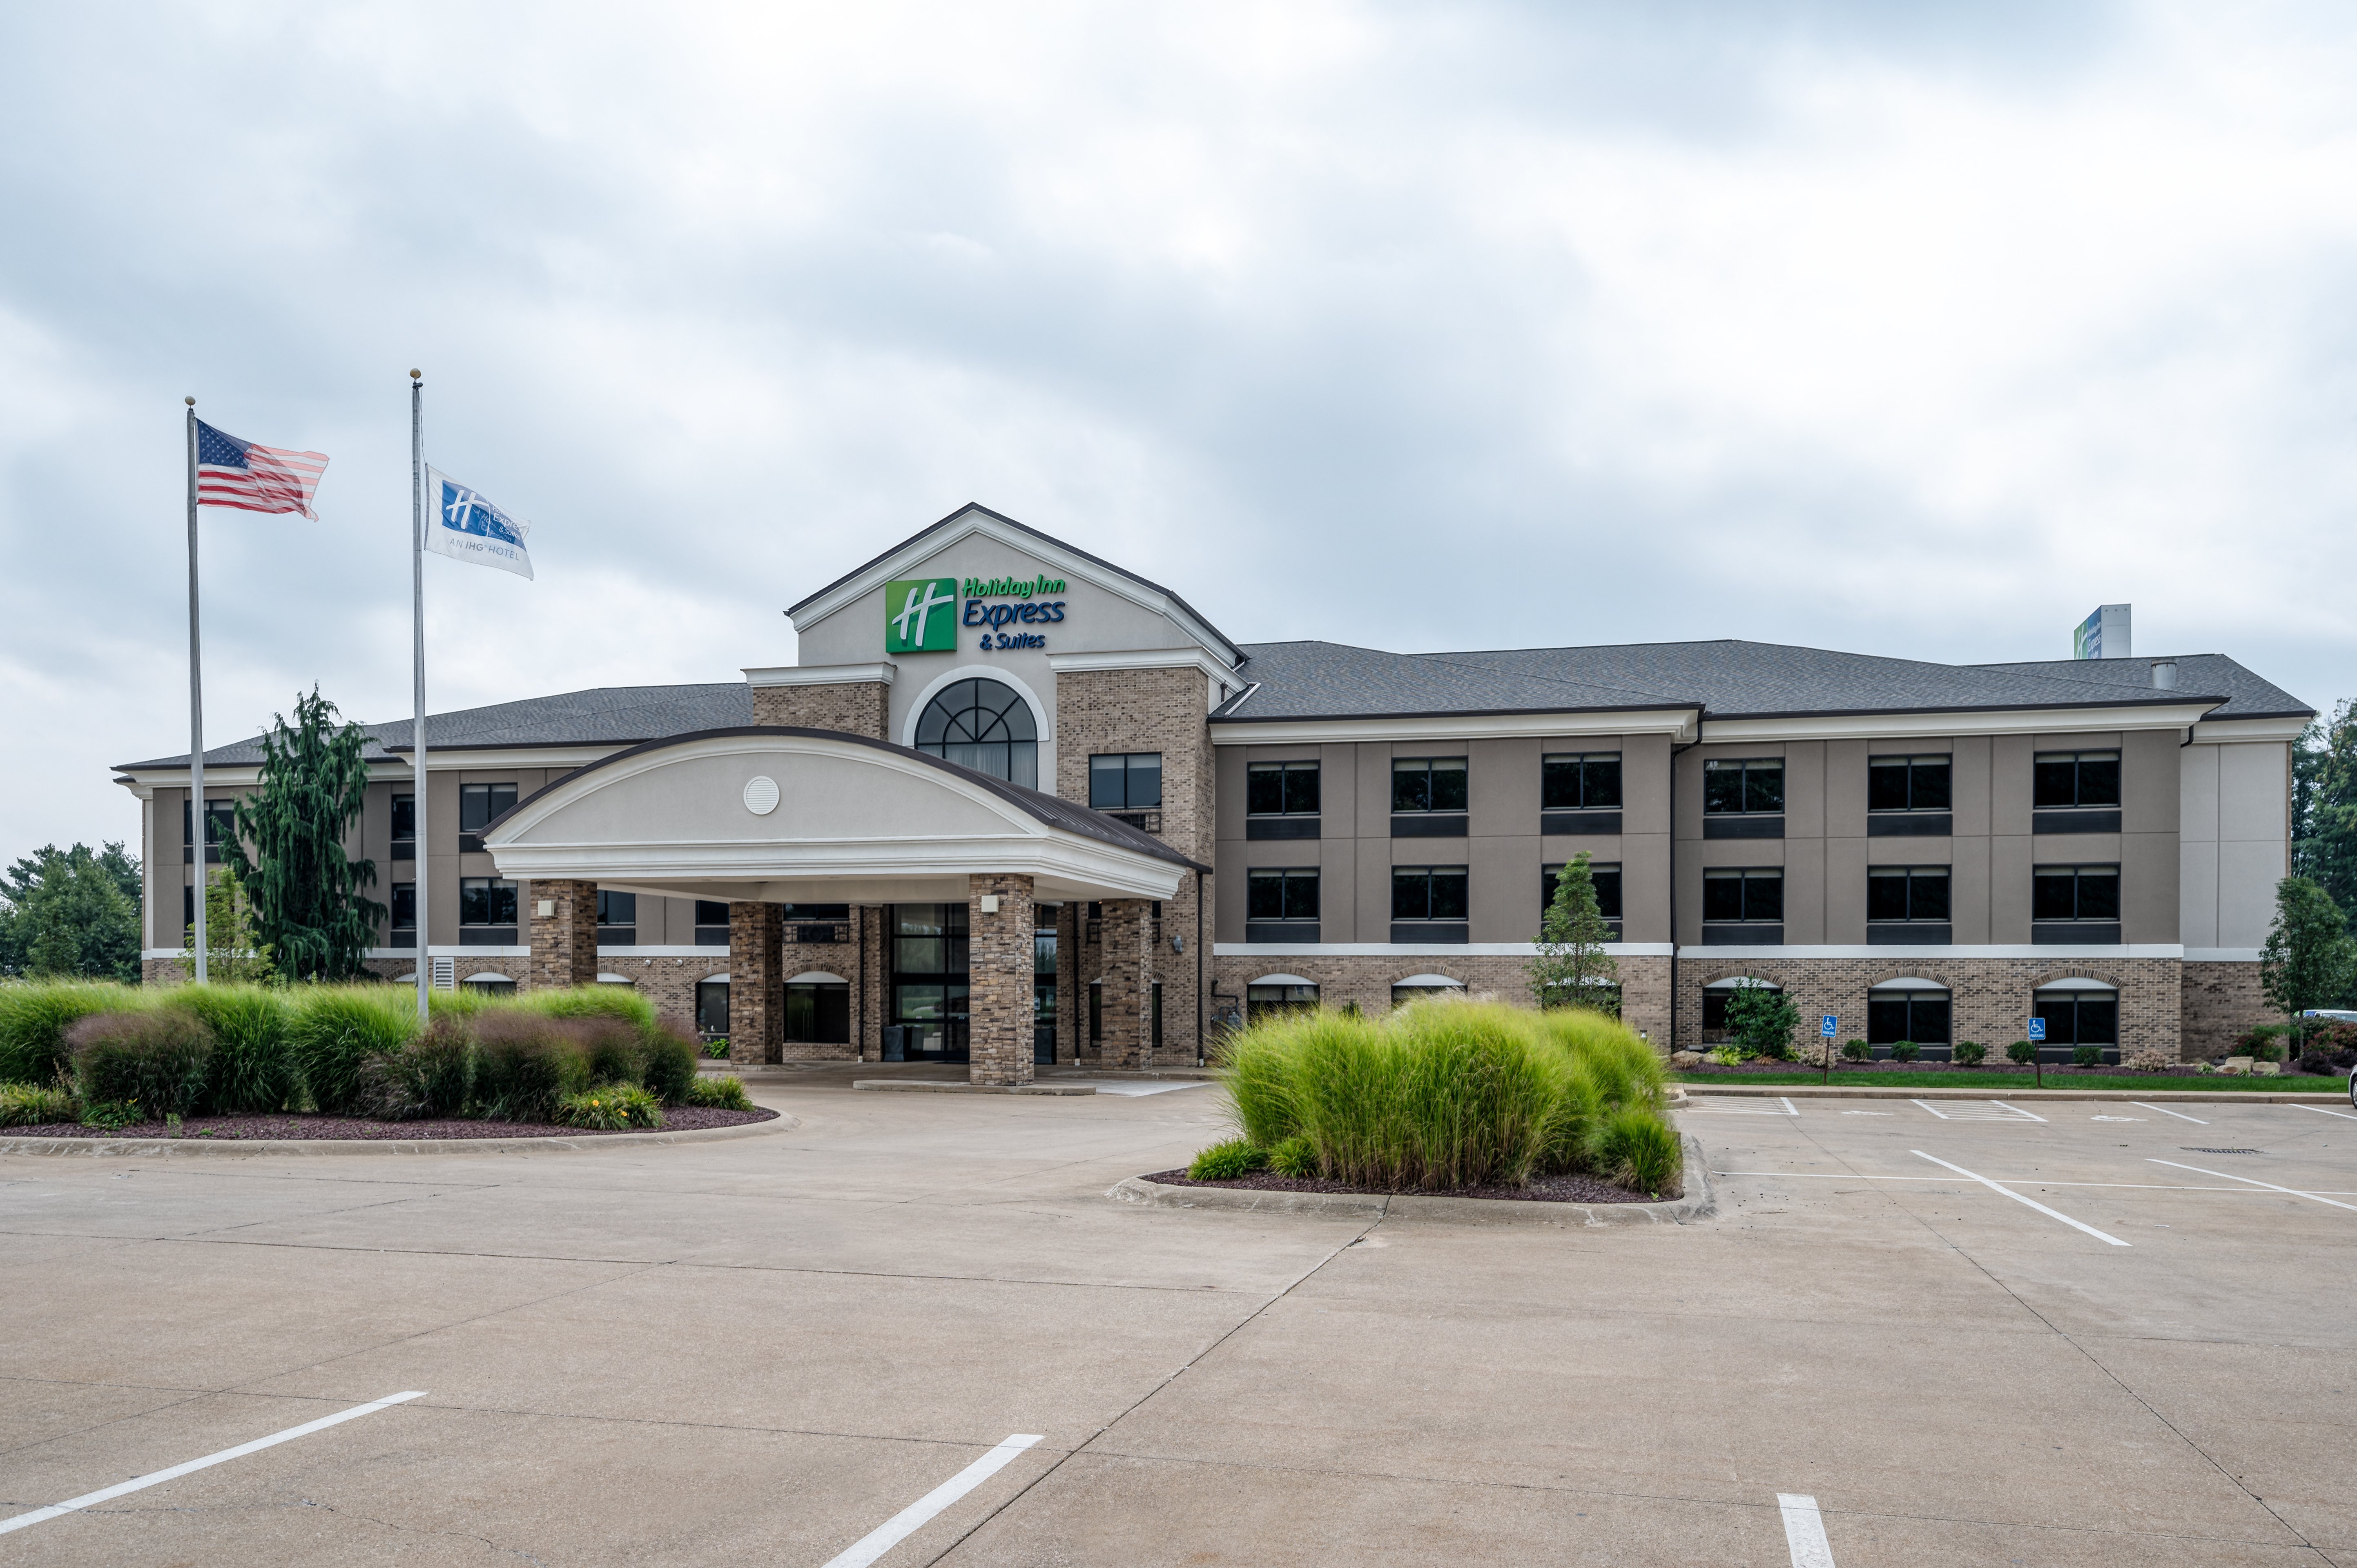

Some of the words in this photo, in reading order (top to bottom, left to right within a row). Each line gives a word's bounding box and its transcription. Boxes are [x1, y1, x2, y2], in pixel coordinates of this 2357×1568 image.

[505, 528, 521, 540] Suites
[450, 538, 463, 548] AN
[465, 541, 484, 551] IHG
[488, 545, 520, 561] HOTEL
[962, 576, 1034, 599] Holiday
[1035, 574, 1066, 594] Inn
[963, 599, 1066, 632] Express
[979, 633, 992, 650] &
[995, 632, 1046, 649] Suites
[2088, 633, 2101, 652] Express
